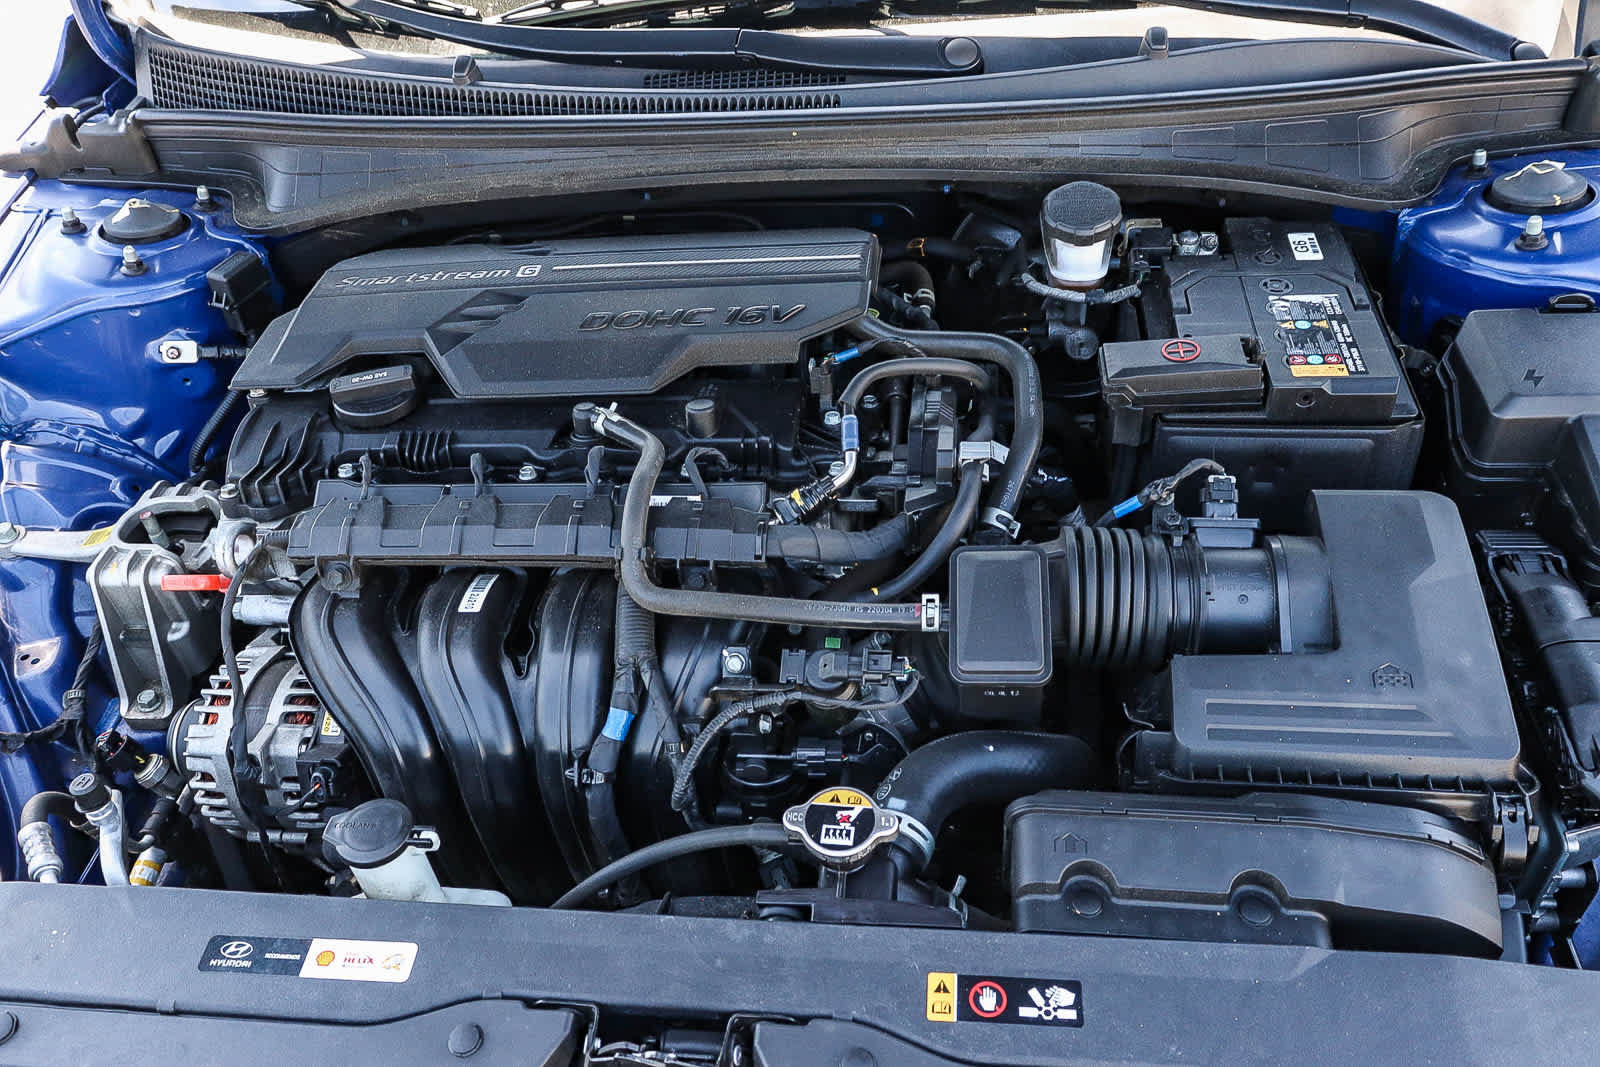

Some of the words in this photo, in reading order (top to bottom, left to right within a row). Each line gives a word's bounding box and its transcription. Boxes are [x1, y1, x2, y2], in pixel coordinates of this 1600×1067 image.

[1292, 240, 1309, 252] G6
[336, 269, 511, 287] Smartstream
[577, 307, 716, 331] DOHC
[722, 304, 806, 325] 16V
[787, 812, 803, 821] HCC
[209, 958, 252, 968] HYUNDAI
